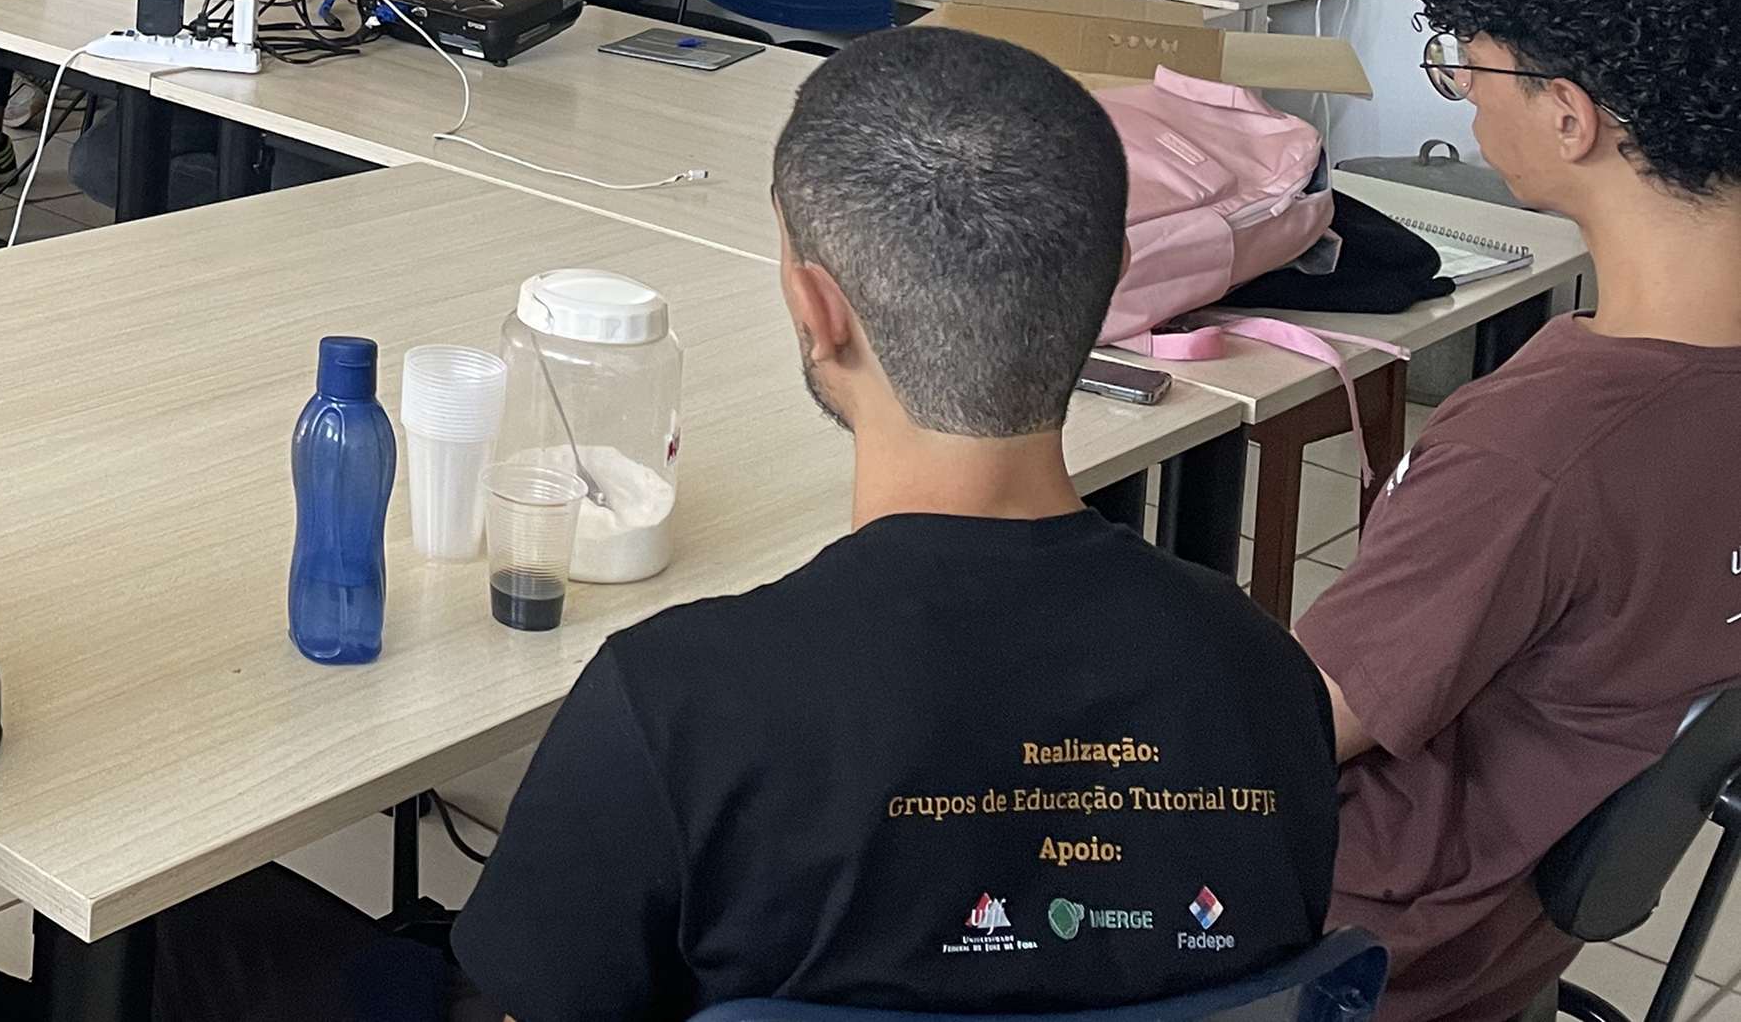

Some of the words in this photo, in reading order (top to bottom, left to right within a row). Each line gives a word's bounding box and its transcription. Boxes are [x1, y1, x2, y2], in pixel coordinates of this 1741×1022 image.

[1022, 736, 1160, 768] Realização:
[888, 795, 976, 821] Grupos
[982, 789, 1008, 813] de
[1012, 786, 1123, 816] Educação
[1129, 786, 1226, 812] Tutorial
[1232, 789, 1278, 817] UFJF
[1039, 836, 1122, 866] Apoio:
[1177, 931, 1235, 952] Fadepe
